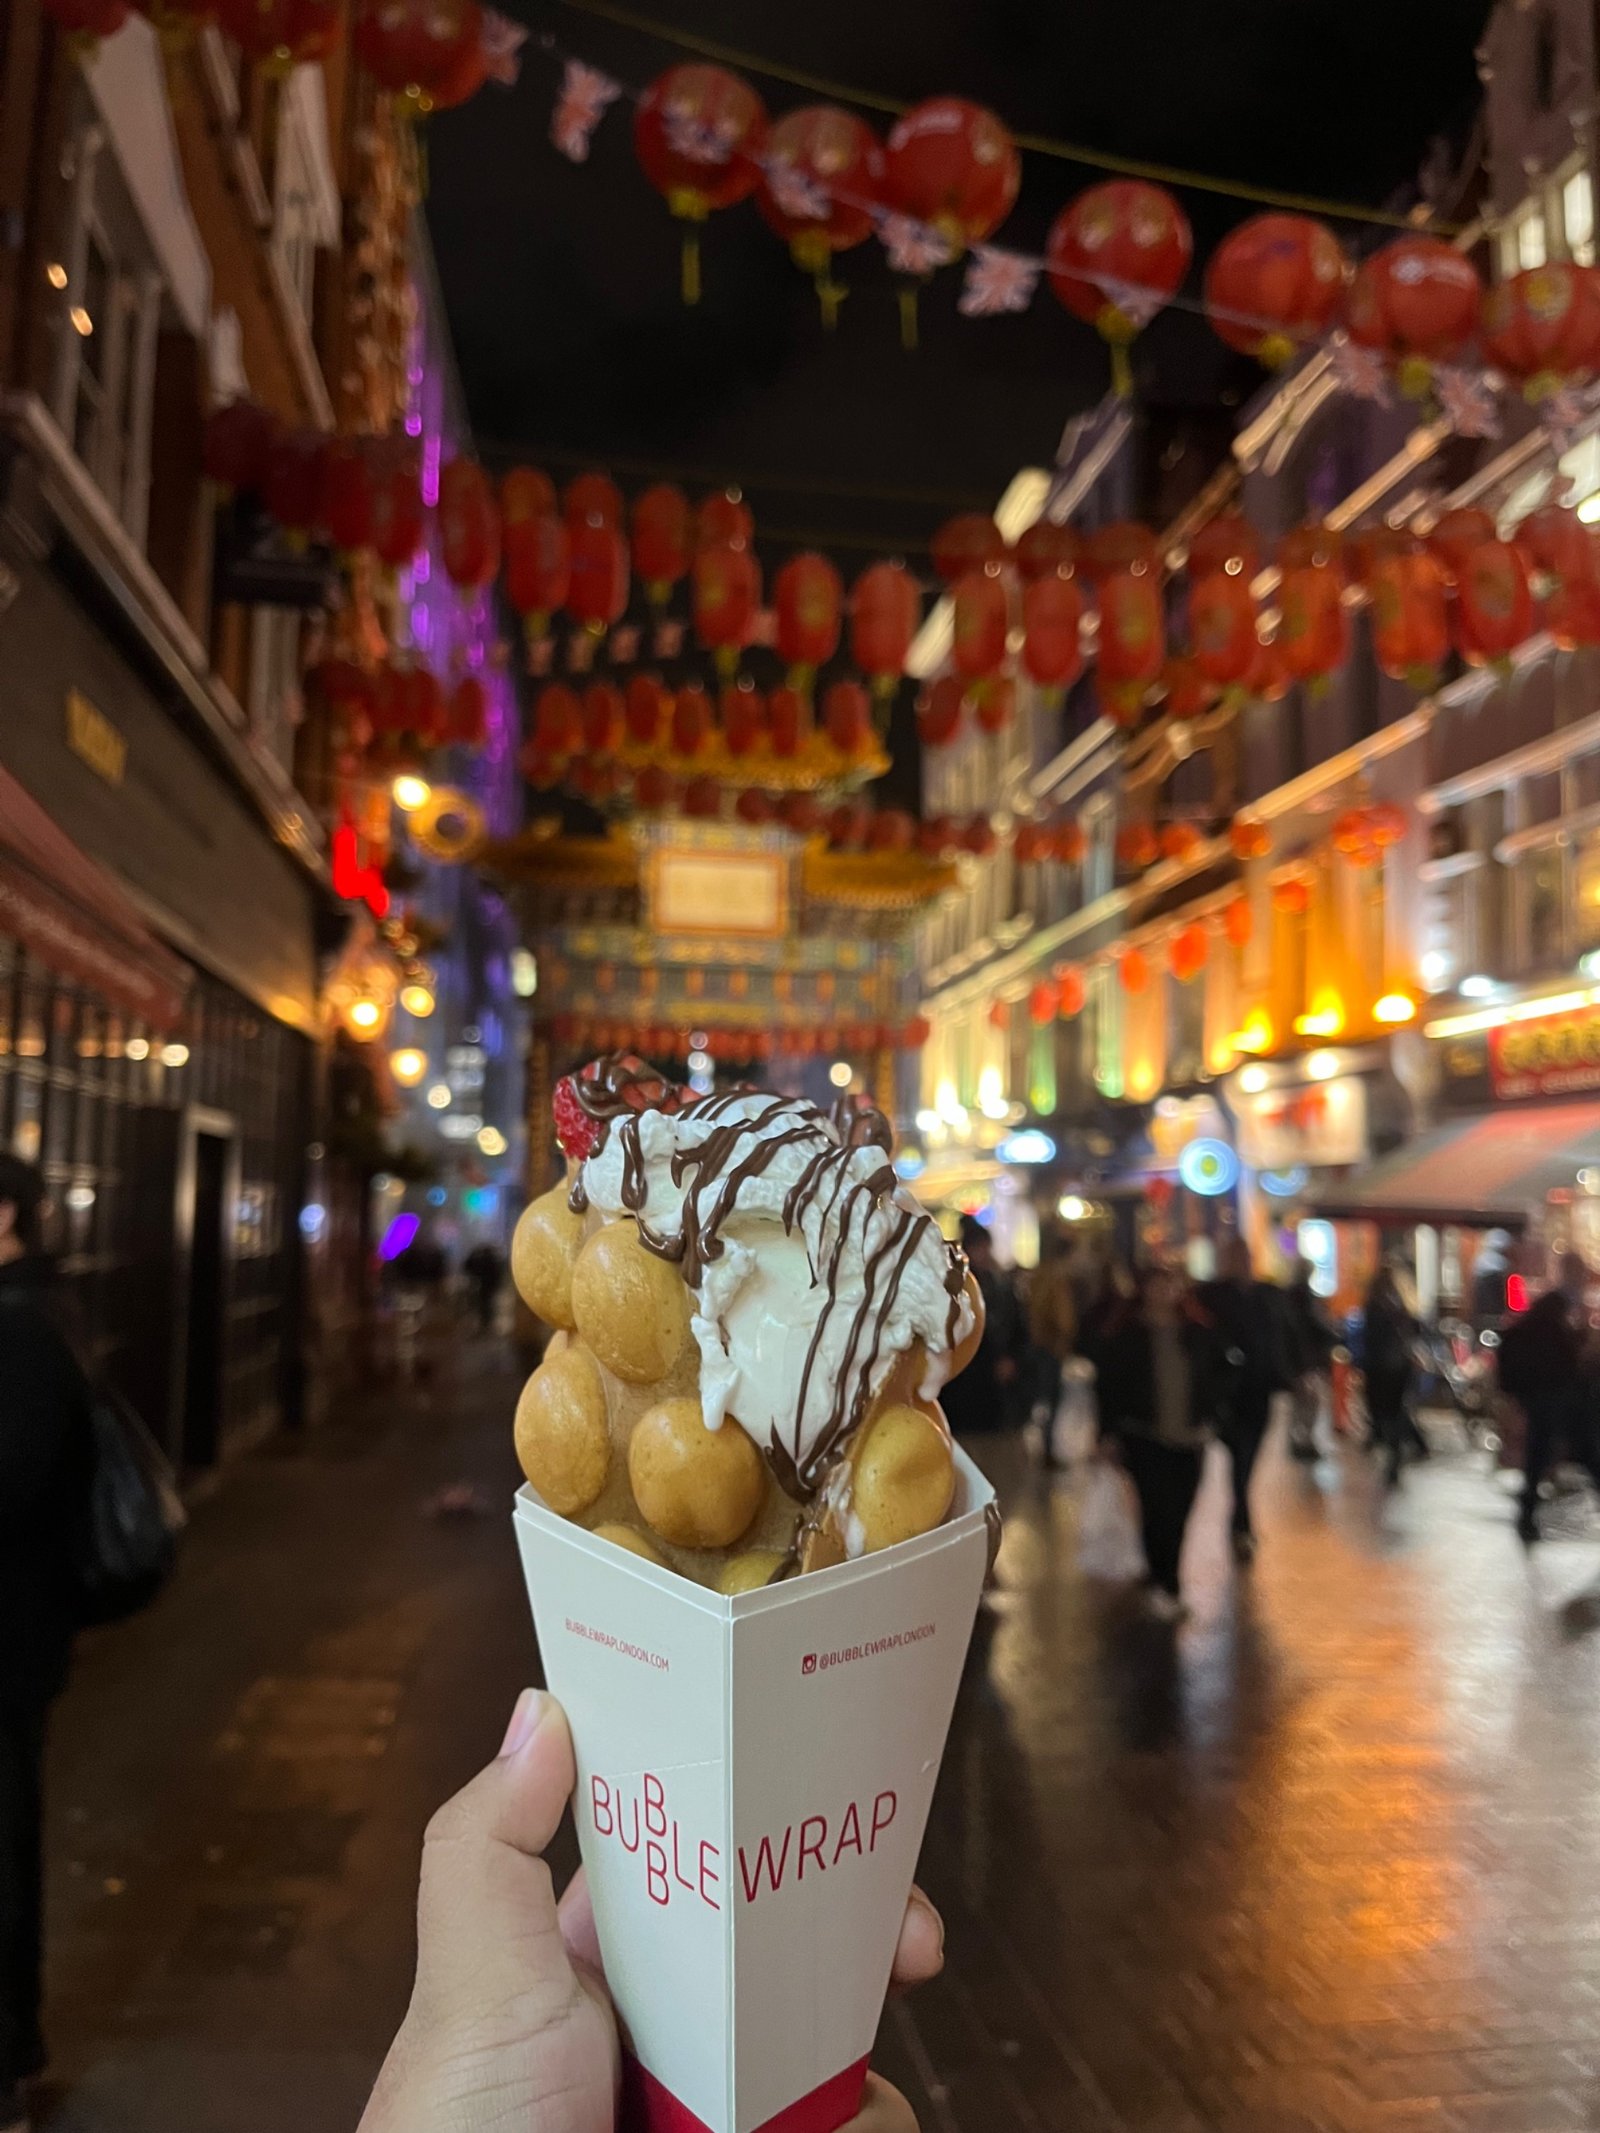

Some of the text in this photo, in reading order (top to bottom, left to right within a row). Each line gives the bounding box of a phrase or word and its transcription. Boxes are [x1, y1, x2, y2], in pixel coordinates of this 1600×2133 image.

[565, 1618, 669, 1671] BUBBLEWRAPLONDON.COM
[819, 1623, 936, 1670] @BUBBLEWRAPLONDON
[591, 1773, 897, 1909] BUBBLE WRAP
